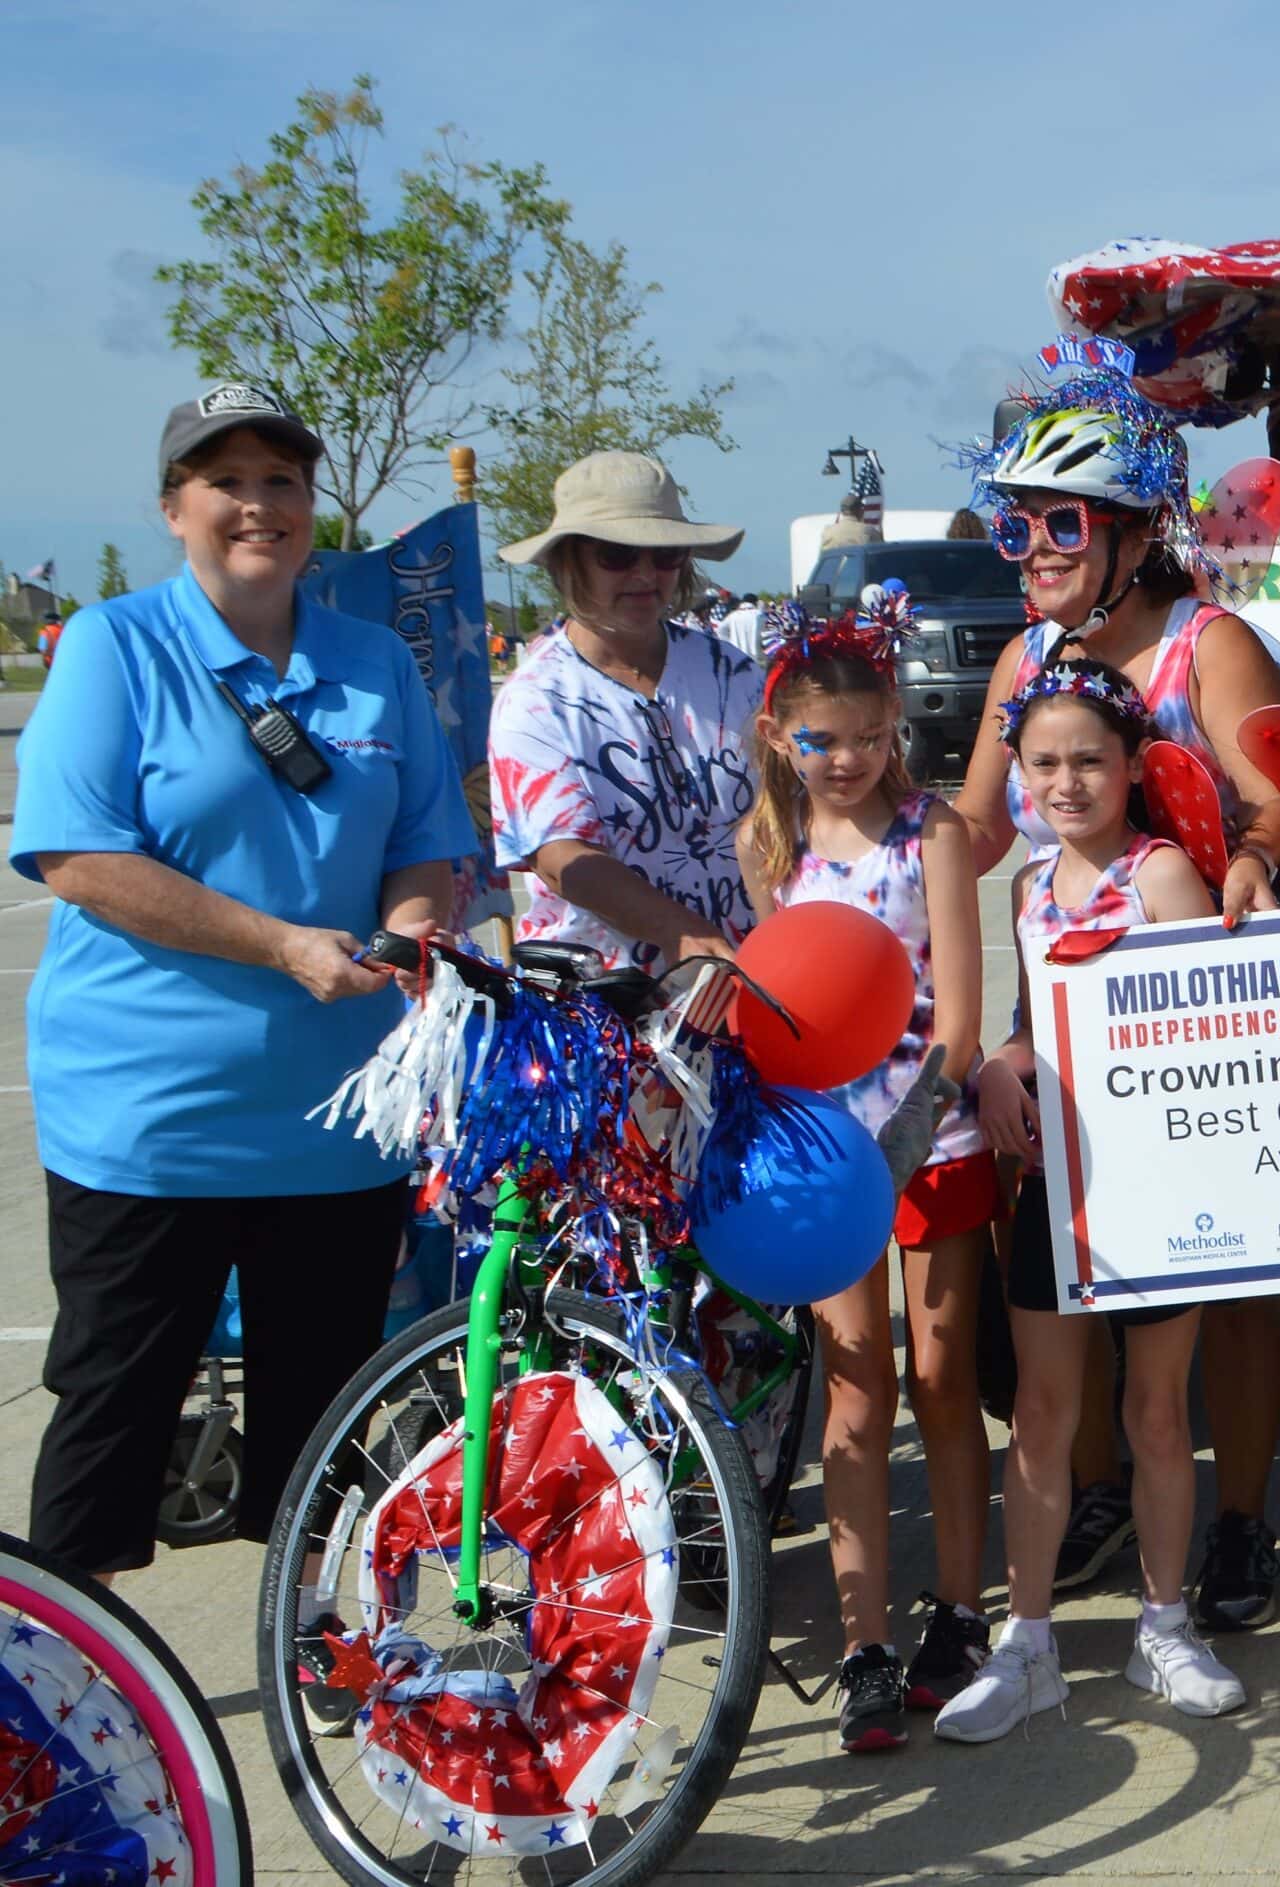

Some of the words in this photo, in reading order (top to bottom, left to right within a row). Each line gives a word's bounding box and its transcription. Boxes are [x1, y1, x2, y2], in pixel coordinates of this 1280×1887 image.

[1165, 1101, 1261, 1140] Best
[1167, 1231, 1247, 1252] Methodist
[264, 1505, 295, 1615] BONTRAGER
